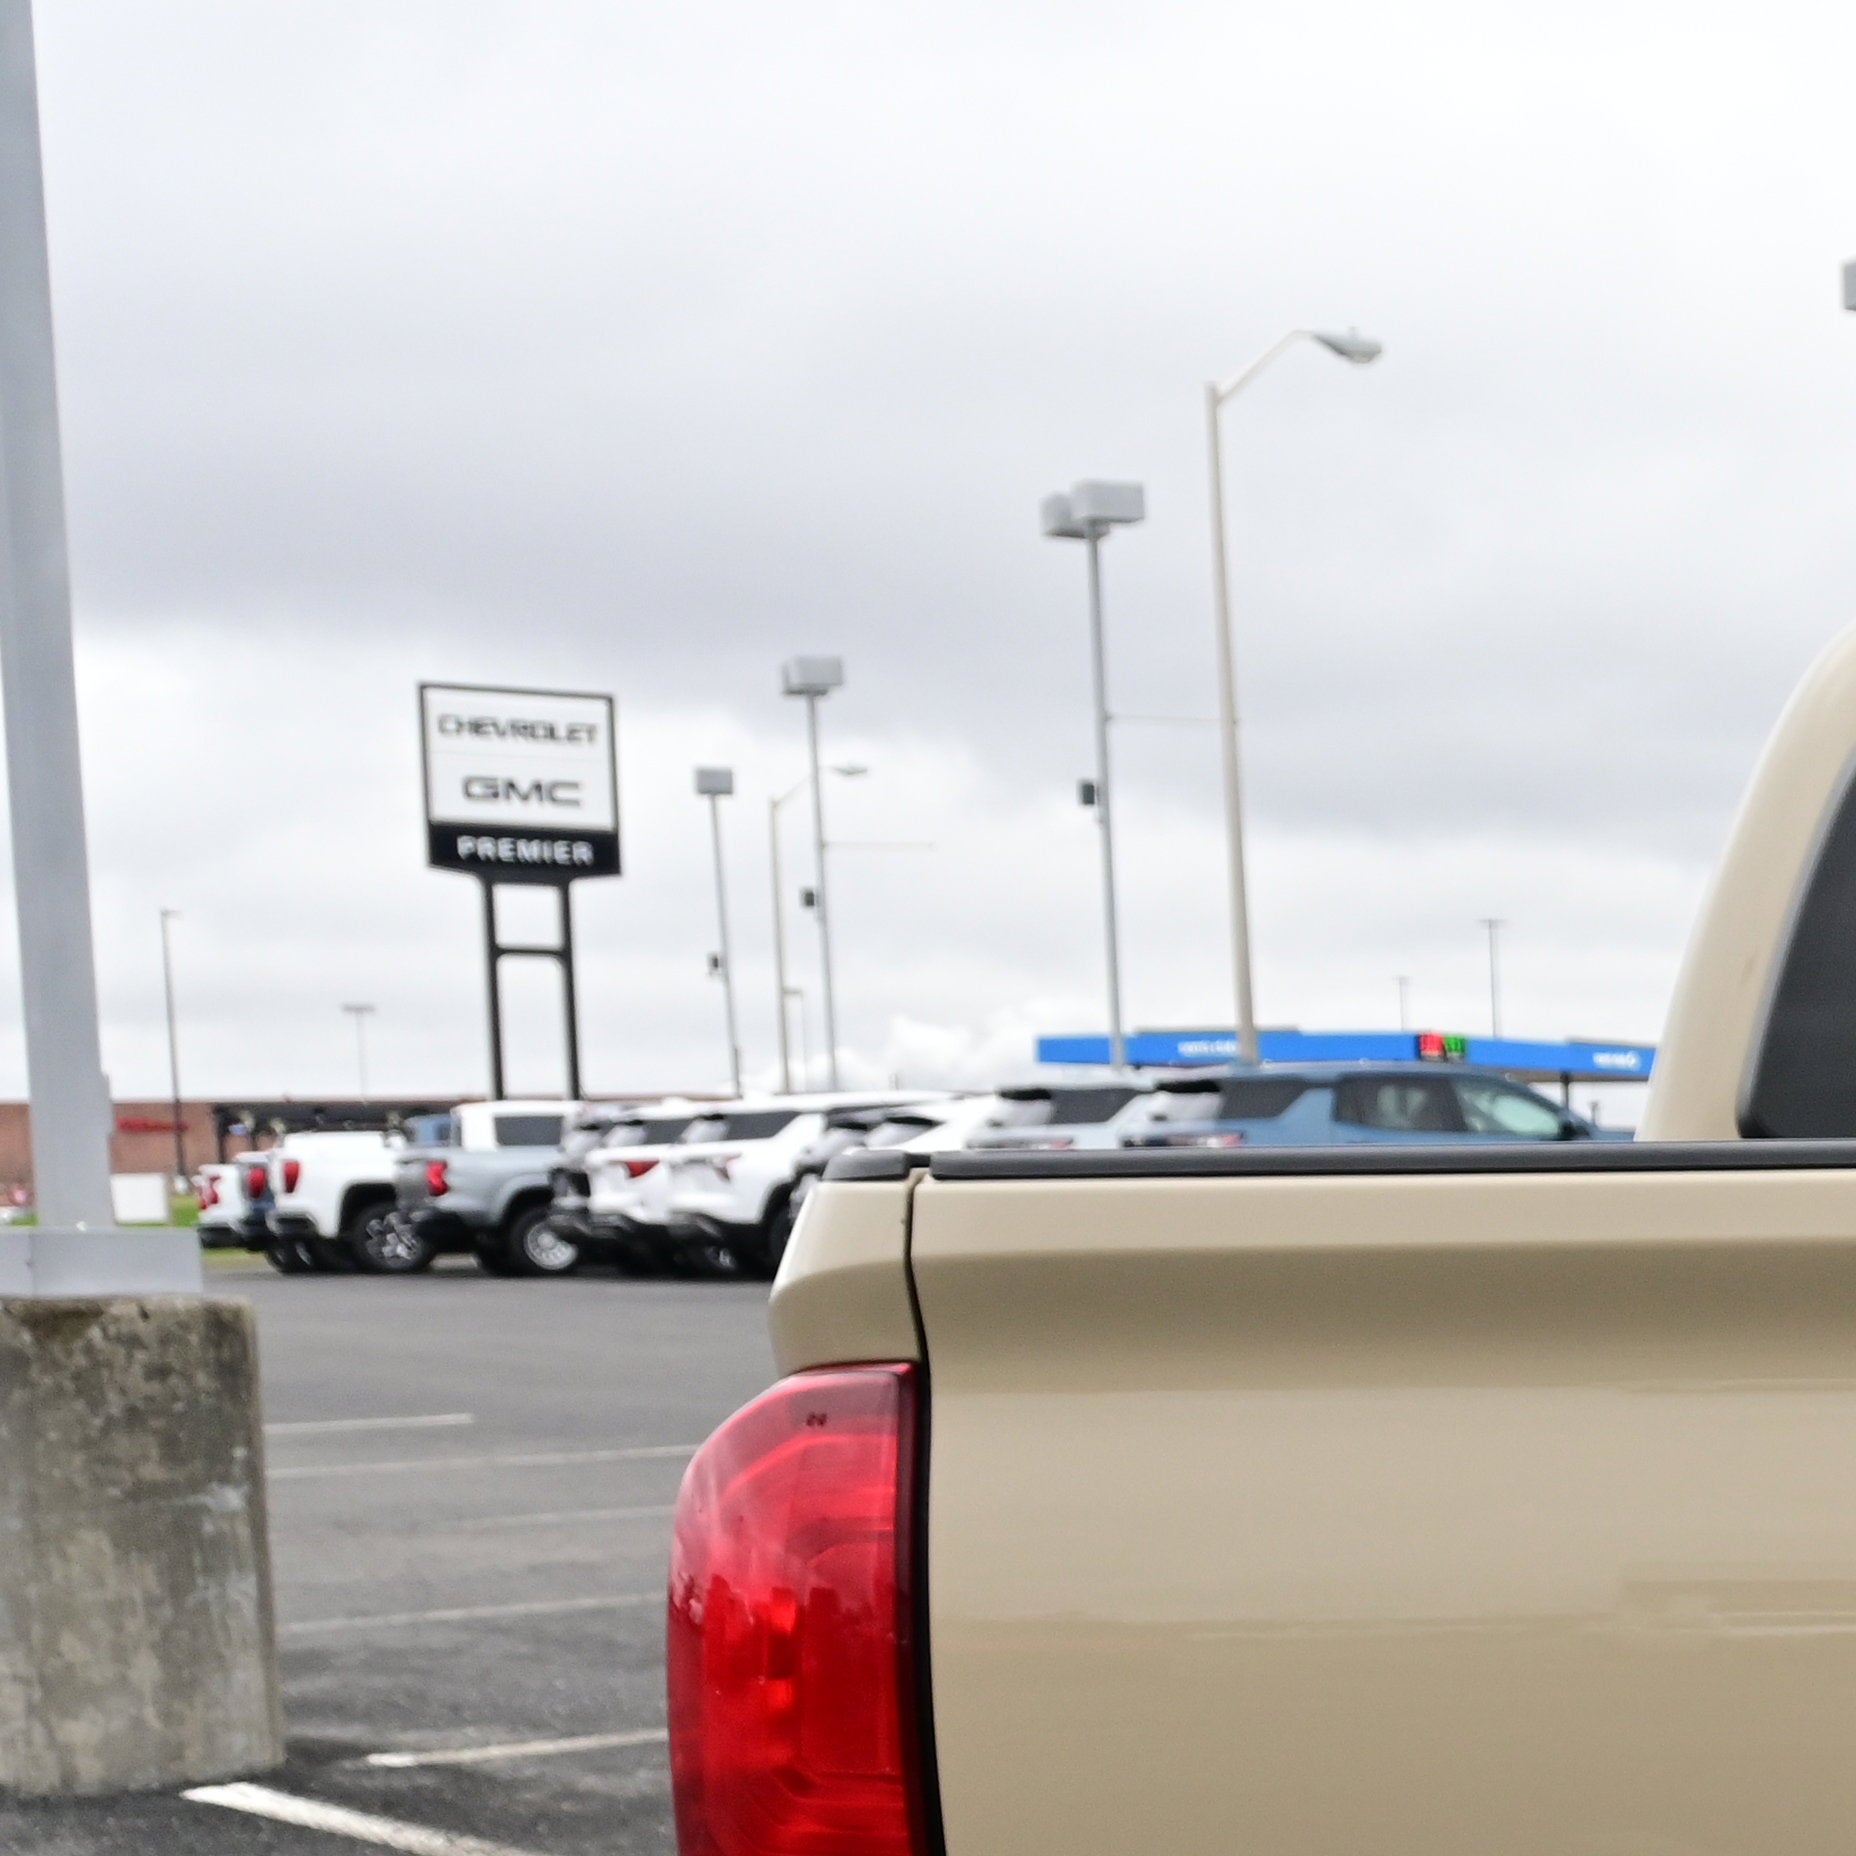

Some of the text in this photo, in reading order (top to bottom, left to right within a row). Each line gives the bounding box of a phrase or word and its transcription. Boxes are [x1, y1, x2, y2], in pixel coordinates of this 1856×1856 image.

[437, 714, 597, 744] CHEVROLET
[462, 775, 582, 807] GMC
[457, 834, 594, 866] PREMIER
